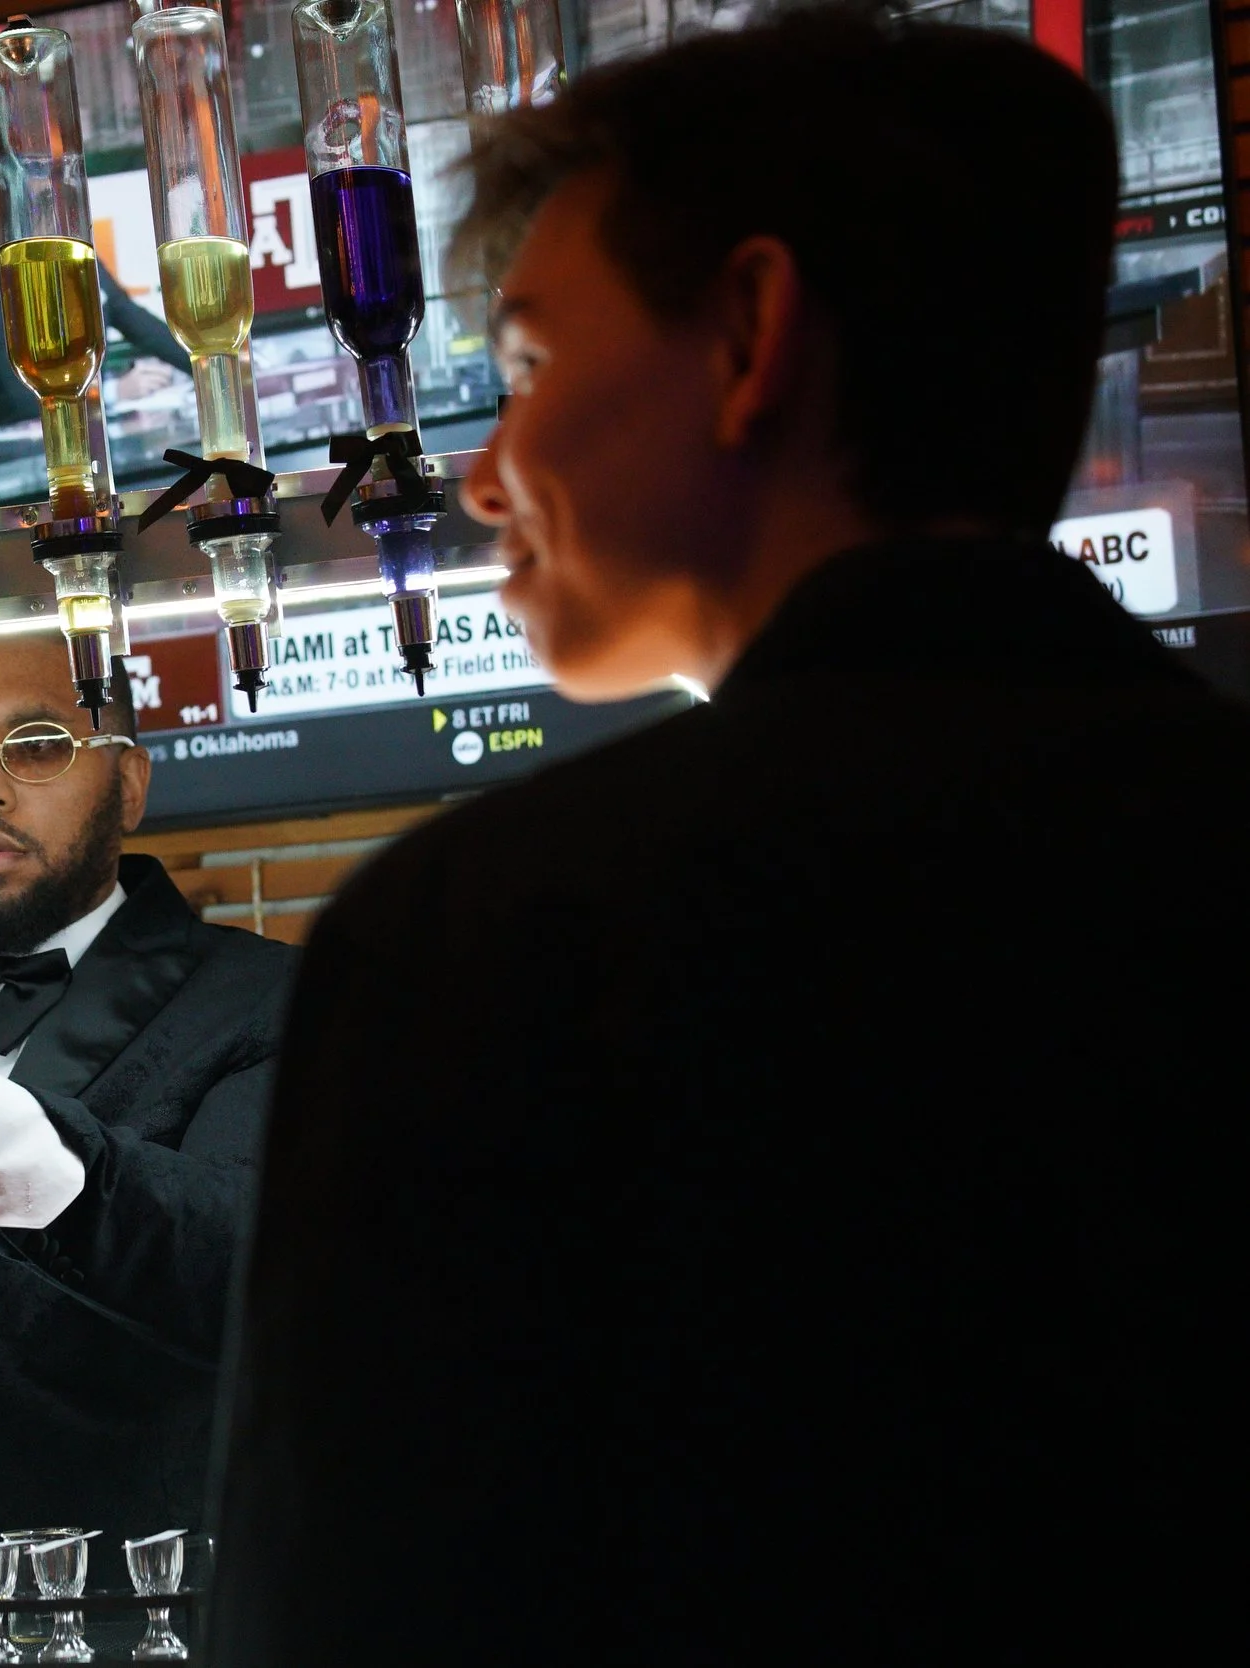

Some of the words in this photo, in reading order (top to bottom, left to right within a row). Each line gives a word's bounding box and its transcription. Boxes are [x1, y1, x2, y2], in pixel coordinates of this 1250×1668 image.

[1186, 206, 1225, 227] CO
[1079, 530, 1149, 566] ABC
[273, 631, 334, 666] IAMI
[344, 629, 369, 657] at
[378, 615, 472, 652] TAS
[483, 611, 523, 641] A&
[327, 668, 359, 691] 7-0
[366, 668, 385, 686] at
[392, 665, 437, 686] Kye
[444, 653, 495, 677] Field
[179, 703, 218, 725] 11-1
[452, 709, 467, 729] 8
[469, 706, 495, 728] ET
[498, 702, 530, 724] FRI
[174, 739, 188, 760] 8
[190, 729, 299, 758] Oklahoma
[489, 728, 543, 752] ESPN
